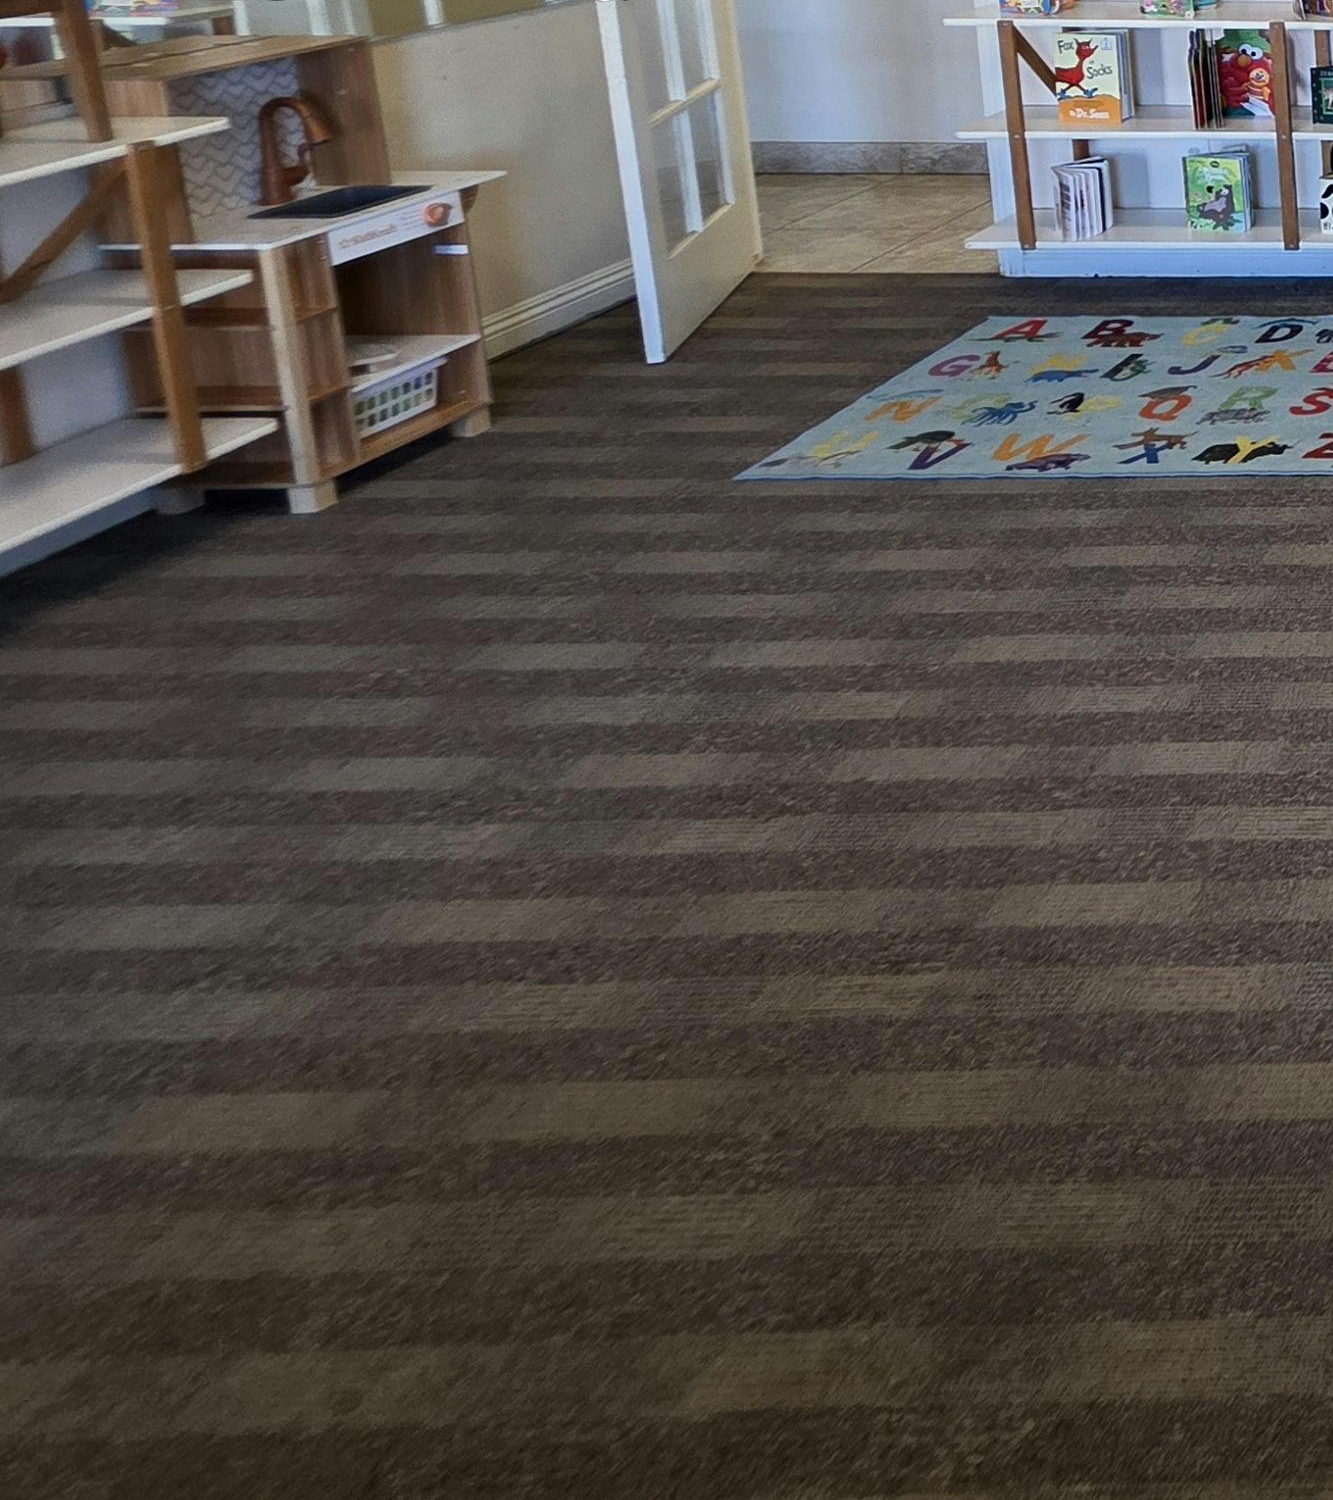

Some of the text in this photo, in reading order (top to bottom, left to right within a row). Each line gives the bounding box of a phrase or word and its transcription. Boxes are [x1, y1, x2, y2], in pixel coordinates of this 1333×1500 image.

[1057, 39, 1075, 54] Fox
[1086, 64, 1113, 79] Socks
[994, 319, 1048, 341] A
[1254, 323, 1303, 344] D
[928, 354, 980, 377] G
[1167, 354, 1222, 375] J
[1139, 394, 1192, 421] Q
[1227, 436, 1280, 465] Y
